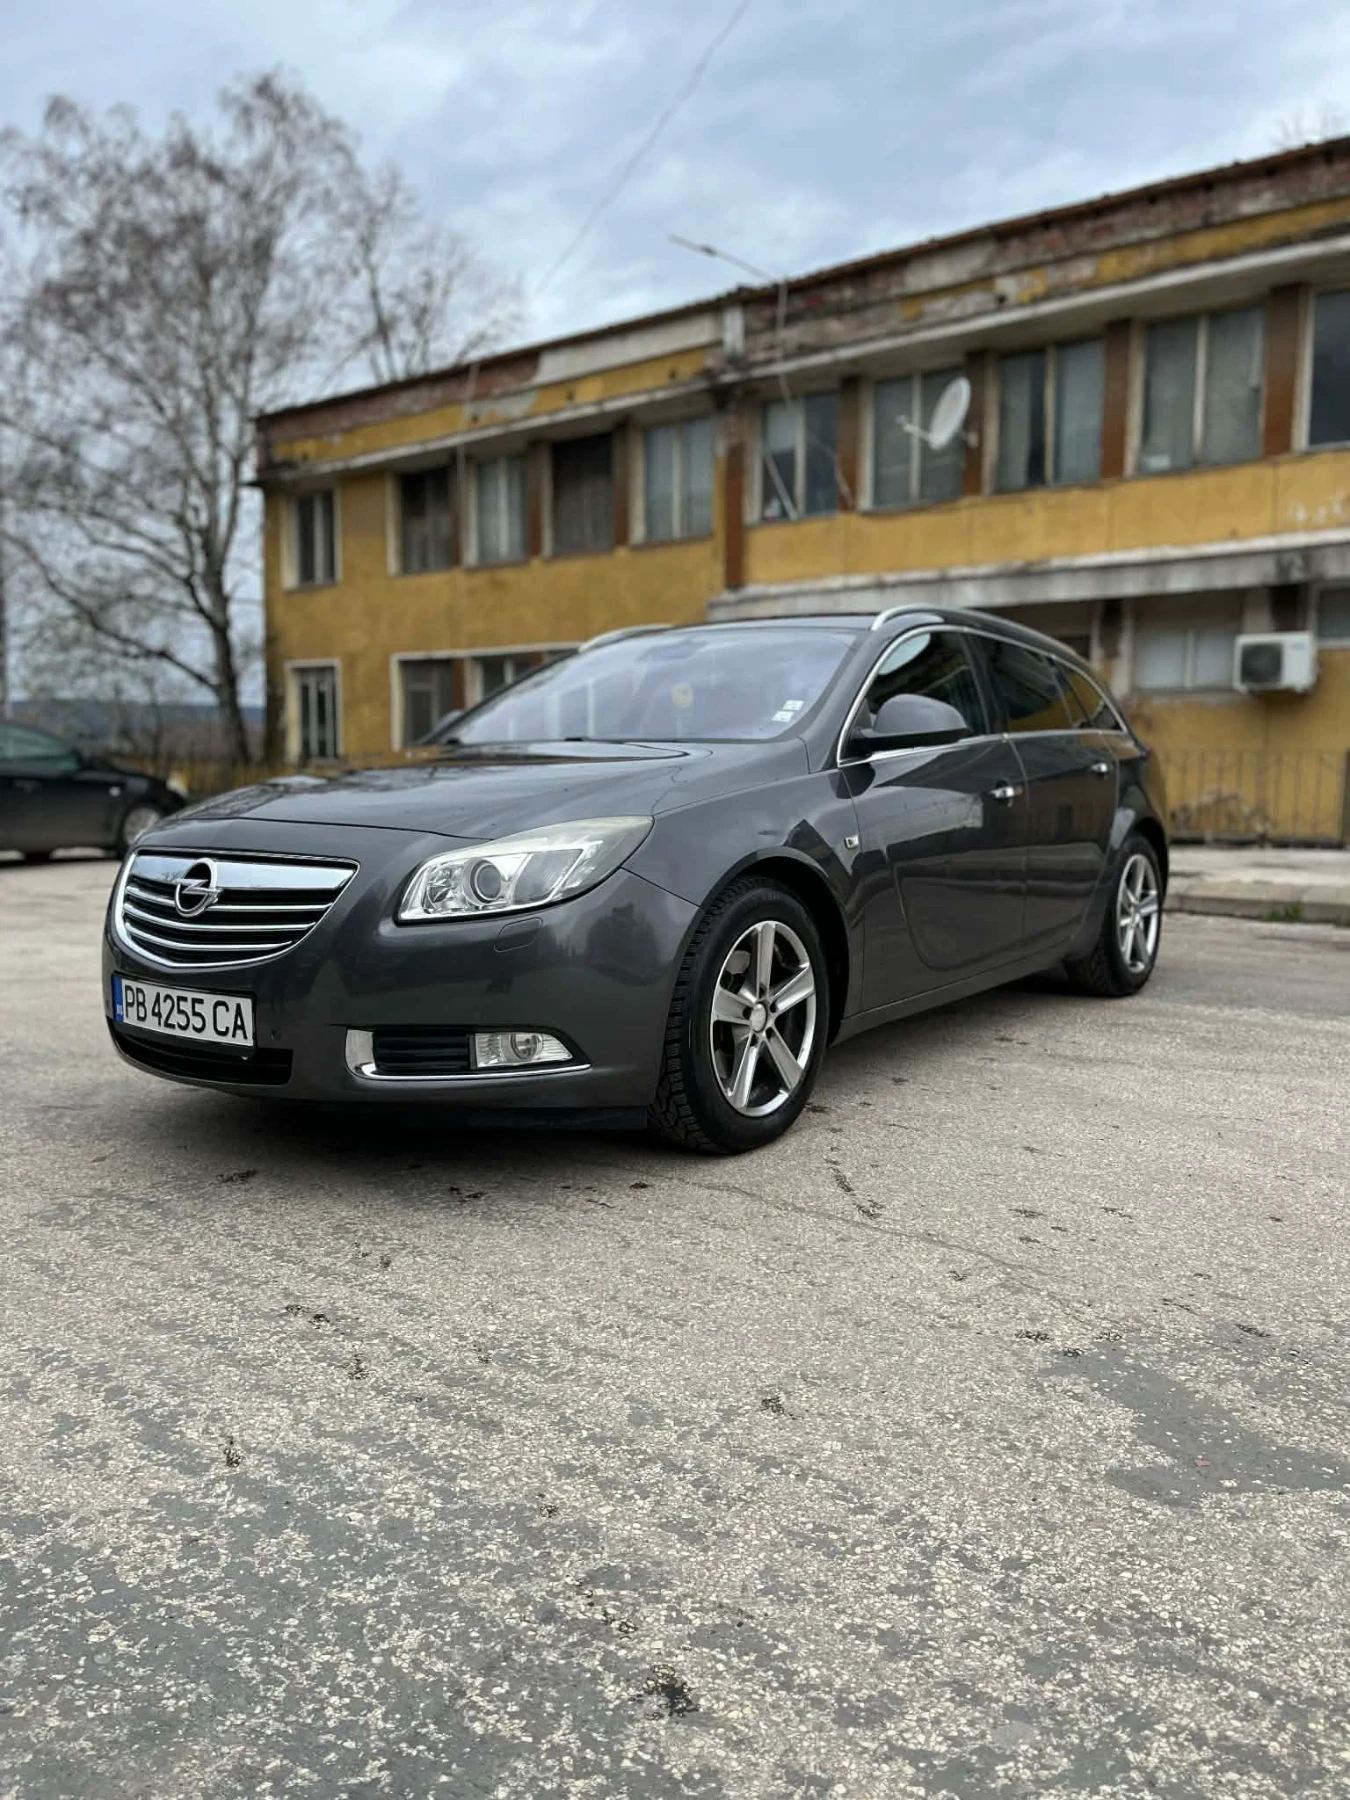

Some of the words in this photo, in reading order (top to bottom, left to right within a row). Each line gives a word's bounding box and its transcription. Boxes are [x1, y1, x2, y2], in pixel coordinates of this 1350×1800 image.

[124, 984, 147, 1022] PB
[151, 991, 207, 1033] 4255
[212, 1000, 248, 1040] CA
